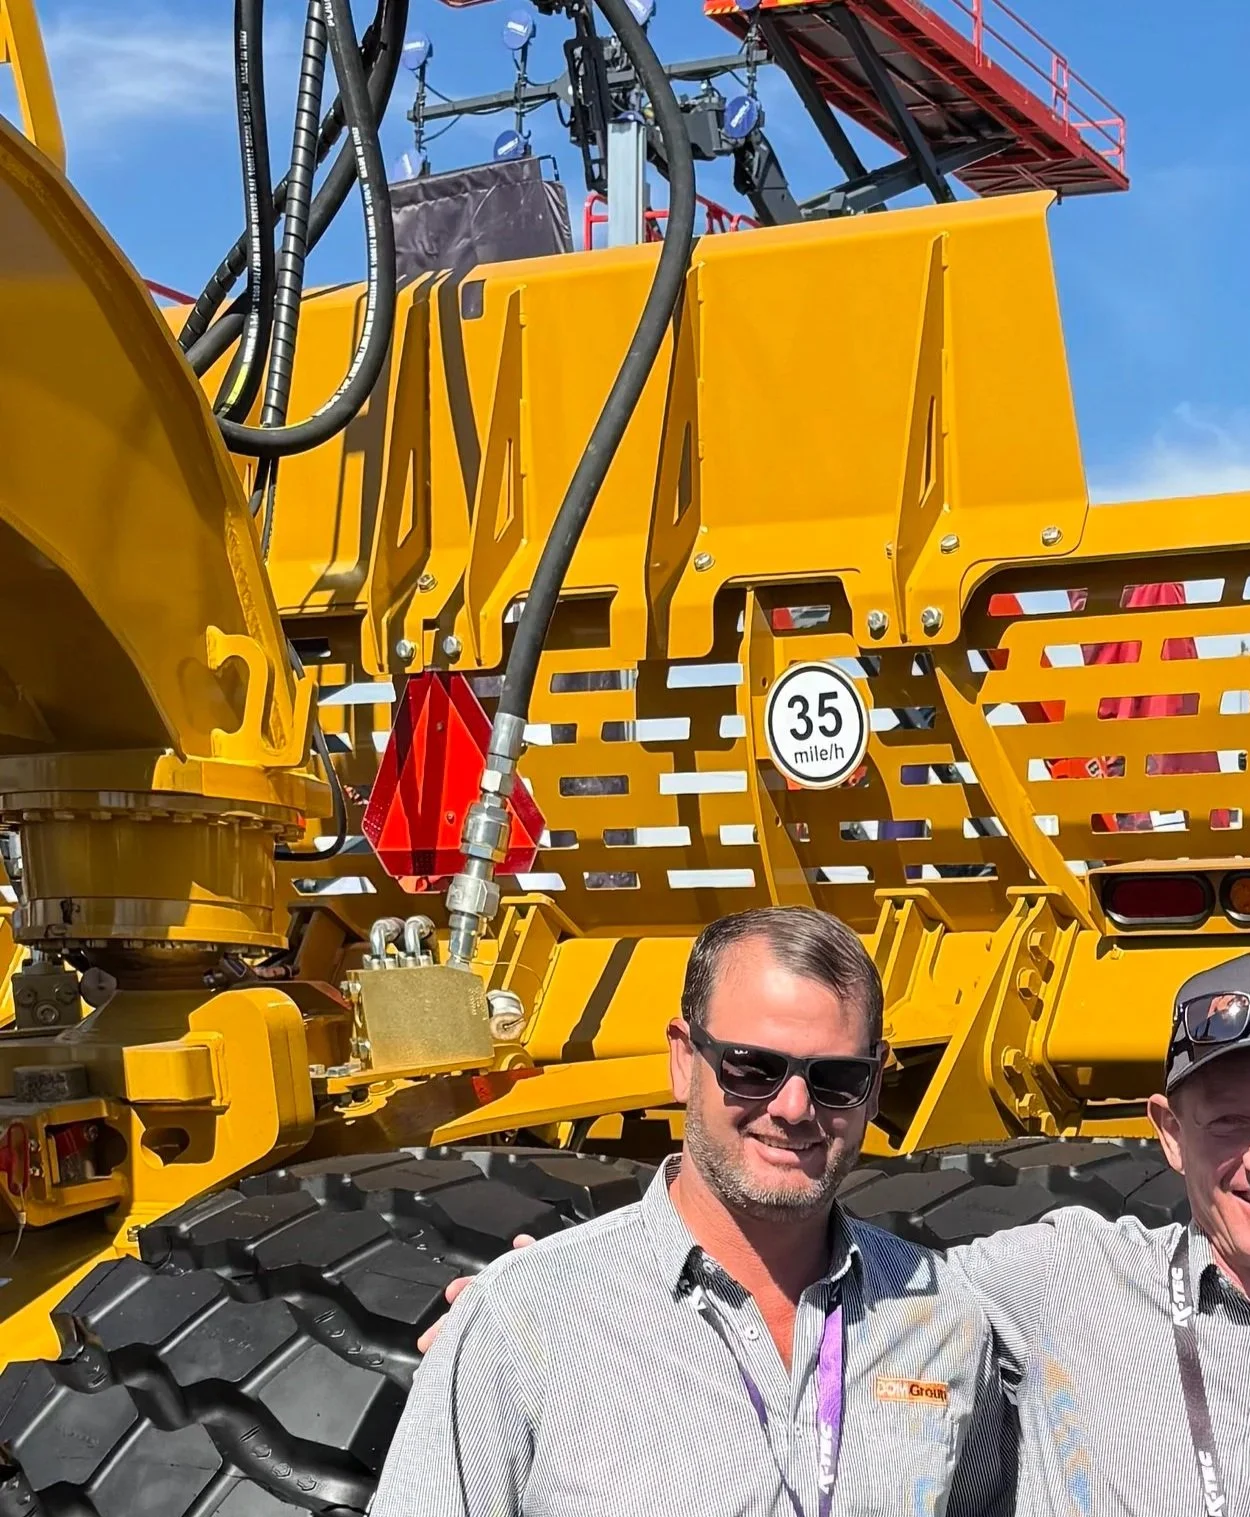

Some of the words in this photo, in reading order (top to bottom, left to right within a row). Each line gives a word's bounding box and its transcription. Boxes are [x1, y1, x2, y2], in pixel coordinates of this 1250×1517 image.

[788, 691, 842, 741] 35
[794, 743, 844, 764] mile/h
[910, 1384, 947, 1402] Group
